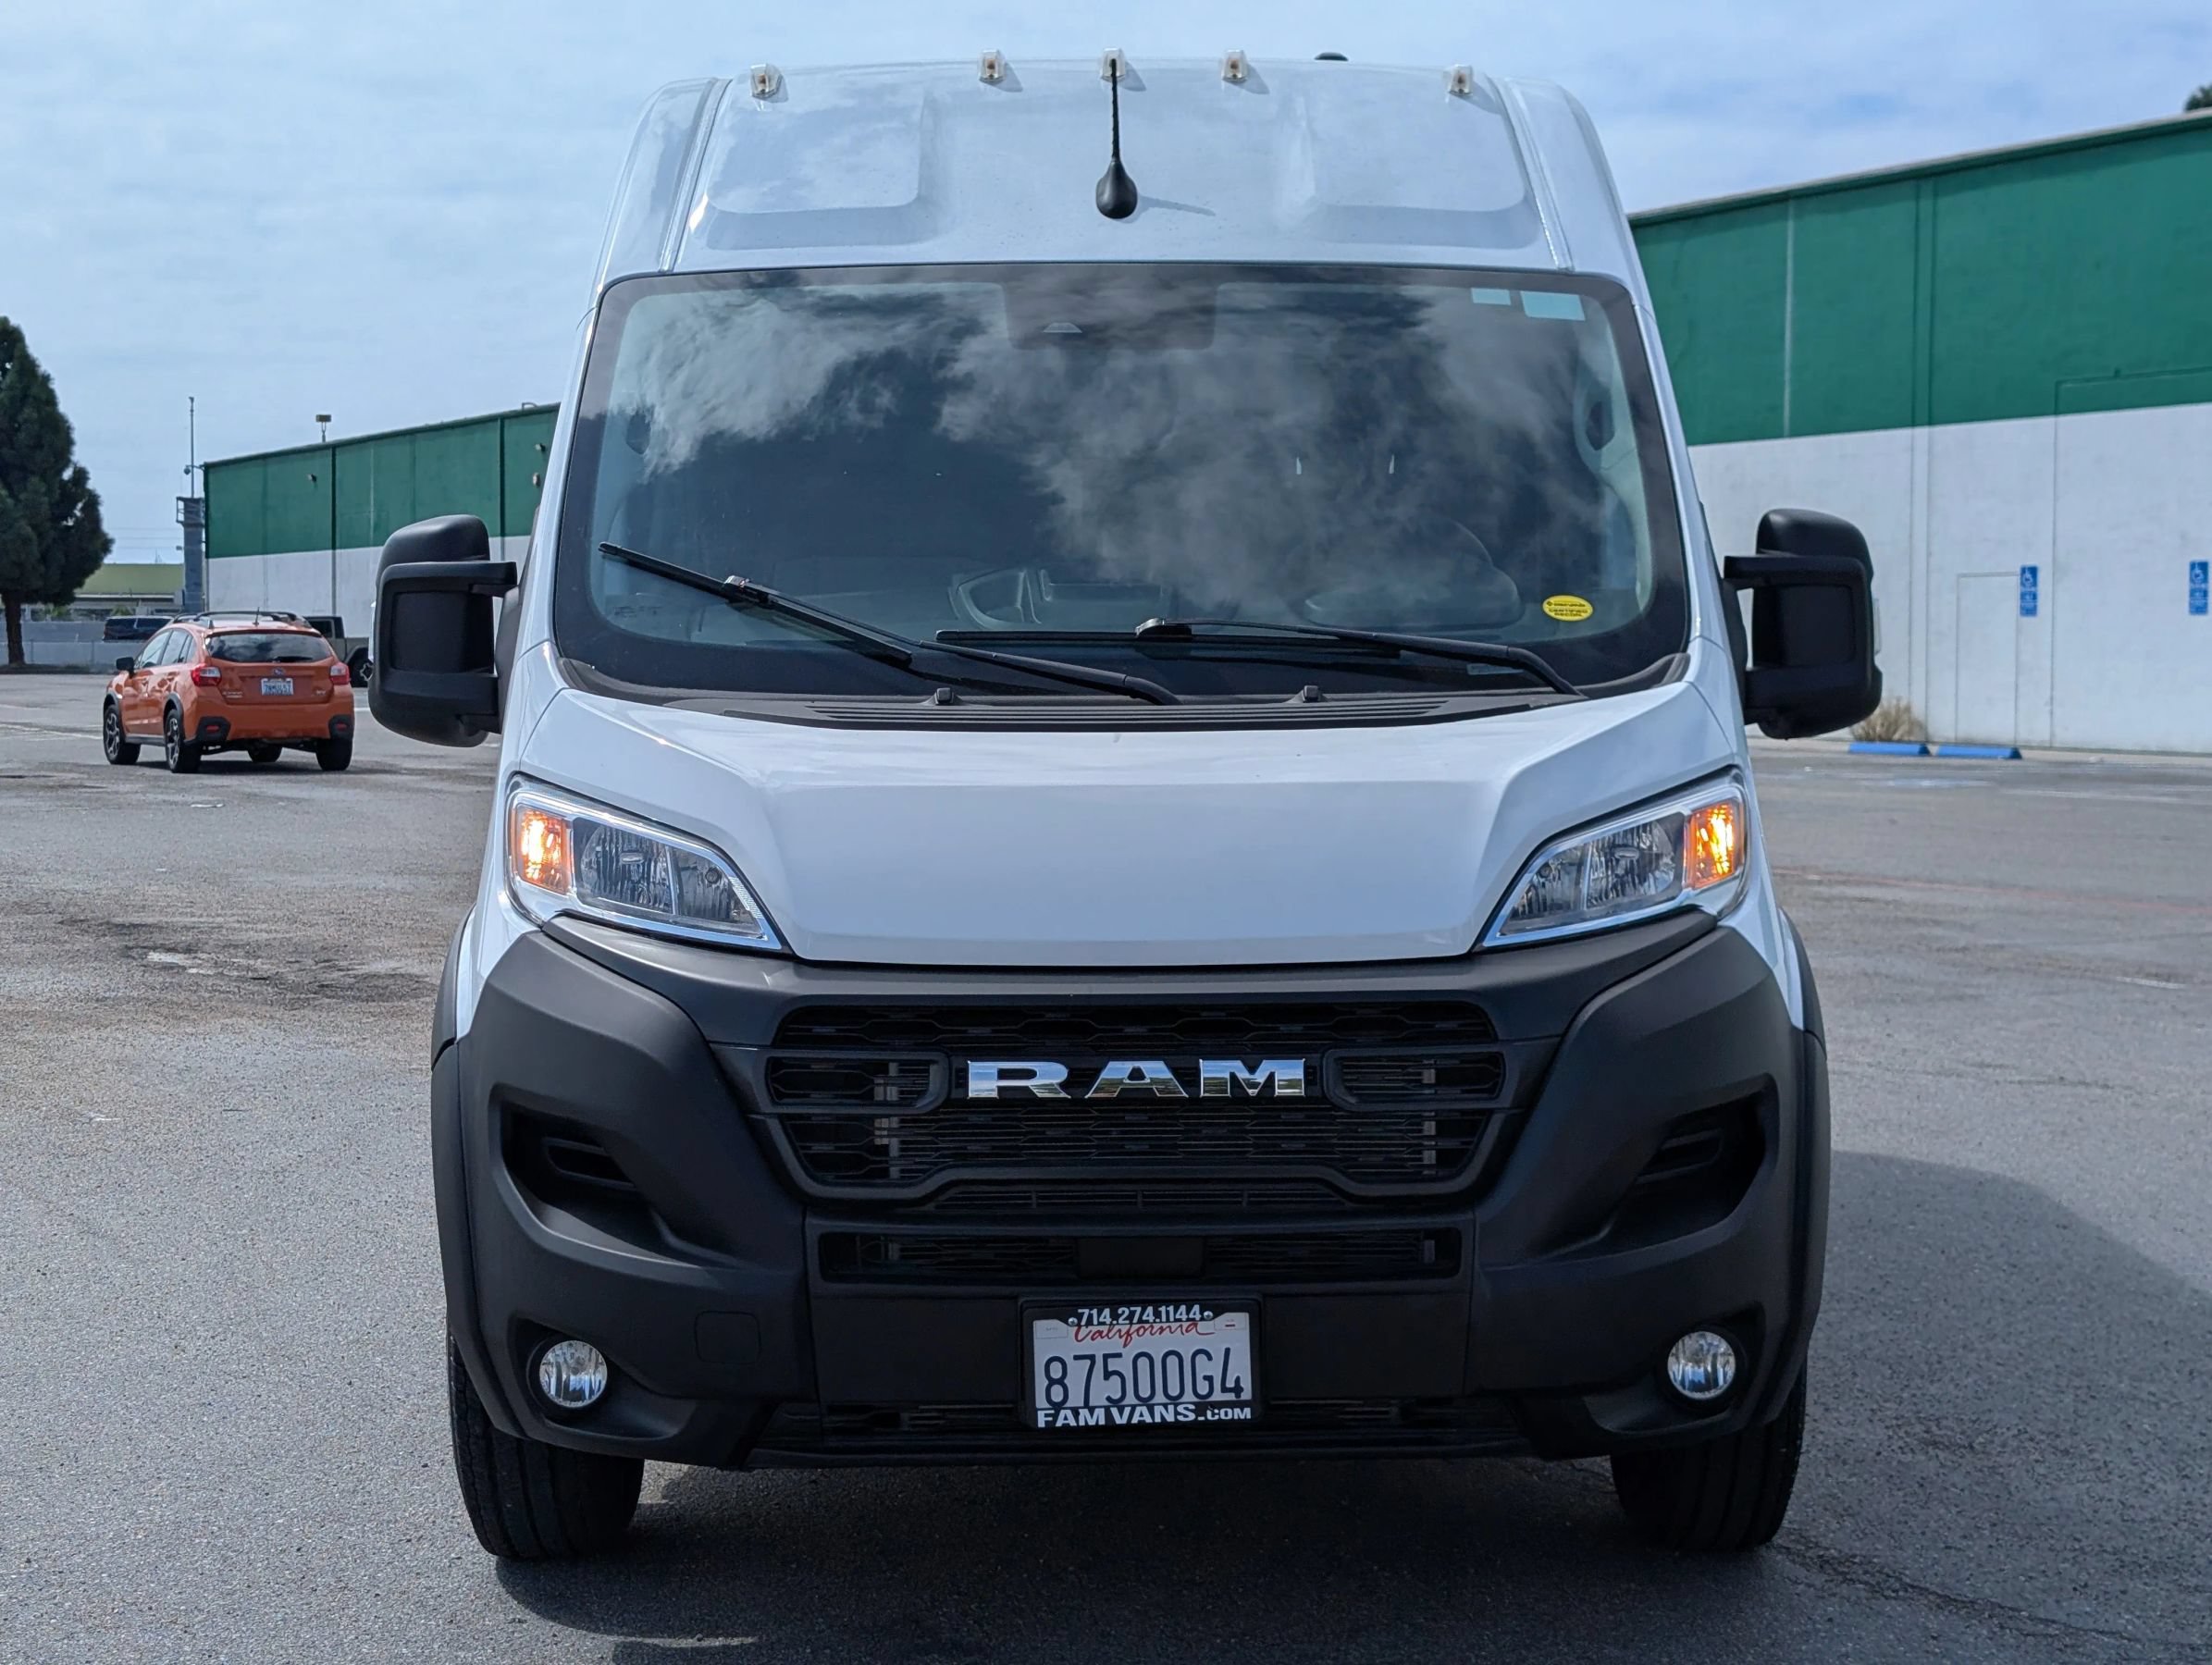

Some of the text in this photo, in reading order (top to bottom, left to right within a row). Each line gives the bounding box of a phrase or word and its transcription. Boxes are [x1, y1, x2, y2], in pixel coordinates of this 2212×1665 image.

[968, 1058, 1305, 1099] RAM
[1078, 1304, 1202, 1326] 714.274.1144
[1074, 1321, 1216, 1349] California
[1044, 1347, 1244, 1408] 87500G4
